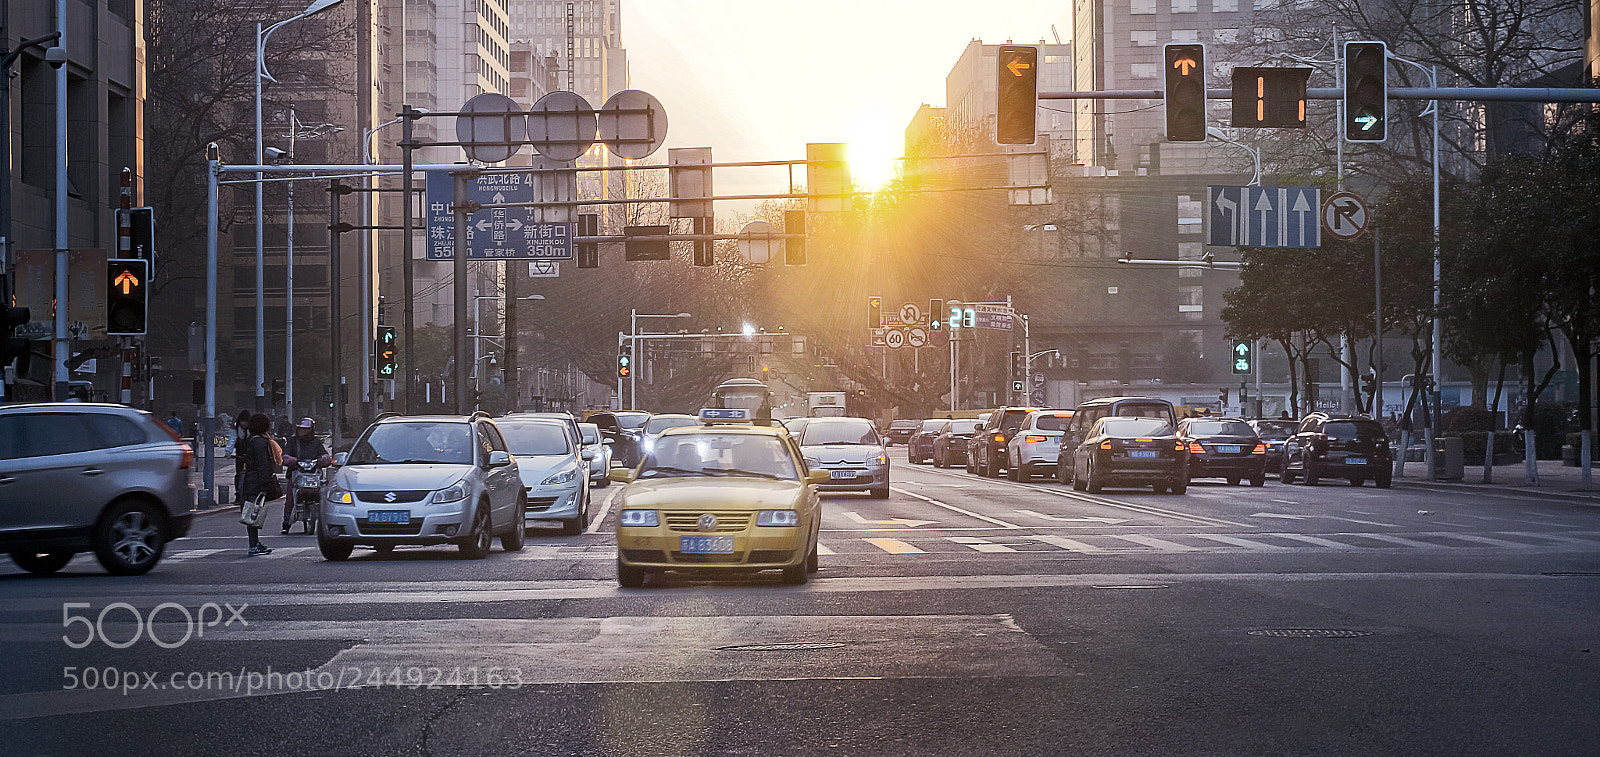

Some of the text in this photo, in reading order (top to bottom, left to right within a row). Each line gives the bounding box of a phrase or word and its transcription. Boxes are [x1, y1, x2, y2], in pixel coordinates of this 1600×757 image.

[477, 174, 520, 185] 洪武北路
[493, 208, 505, 240] 华侨路
[523, 224, 566, 239] 新街口
[483, 248, 516, 257] 管家桥
[527, 246, 566, 257] 350m
[888, 334, 902, 344] 60
